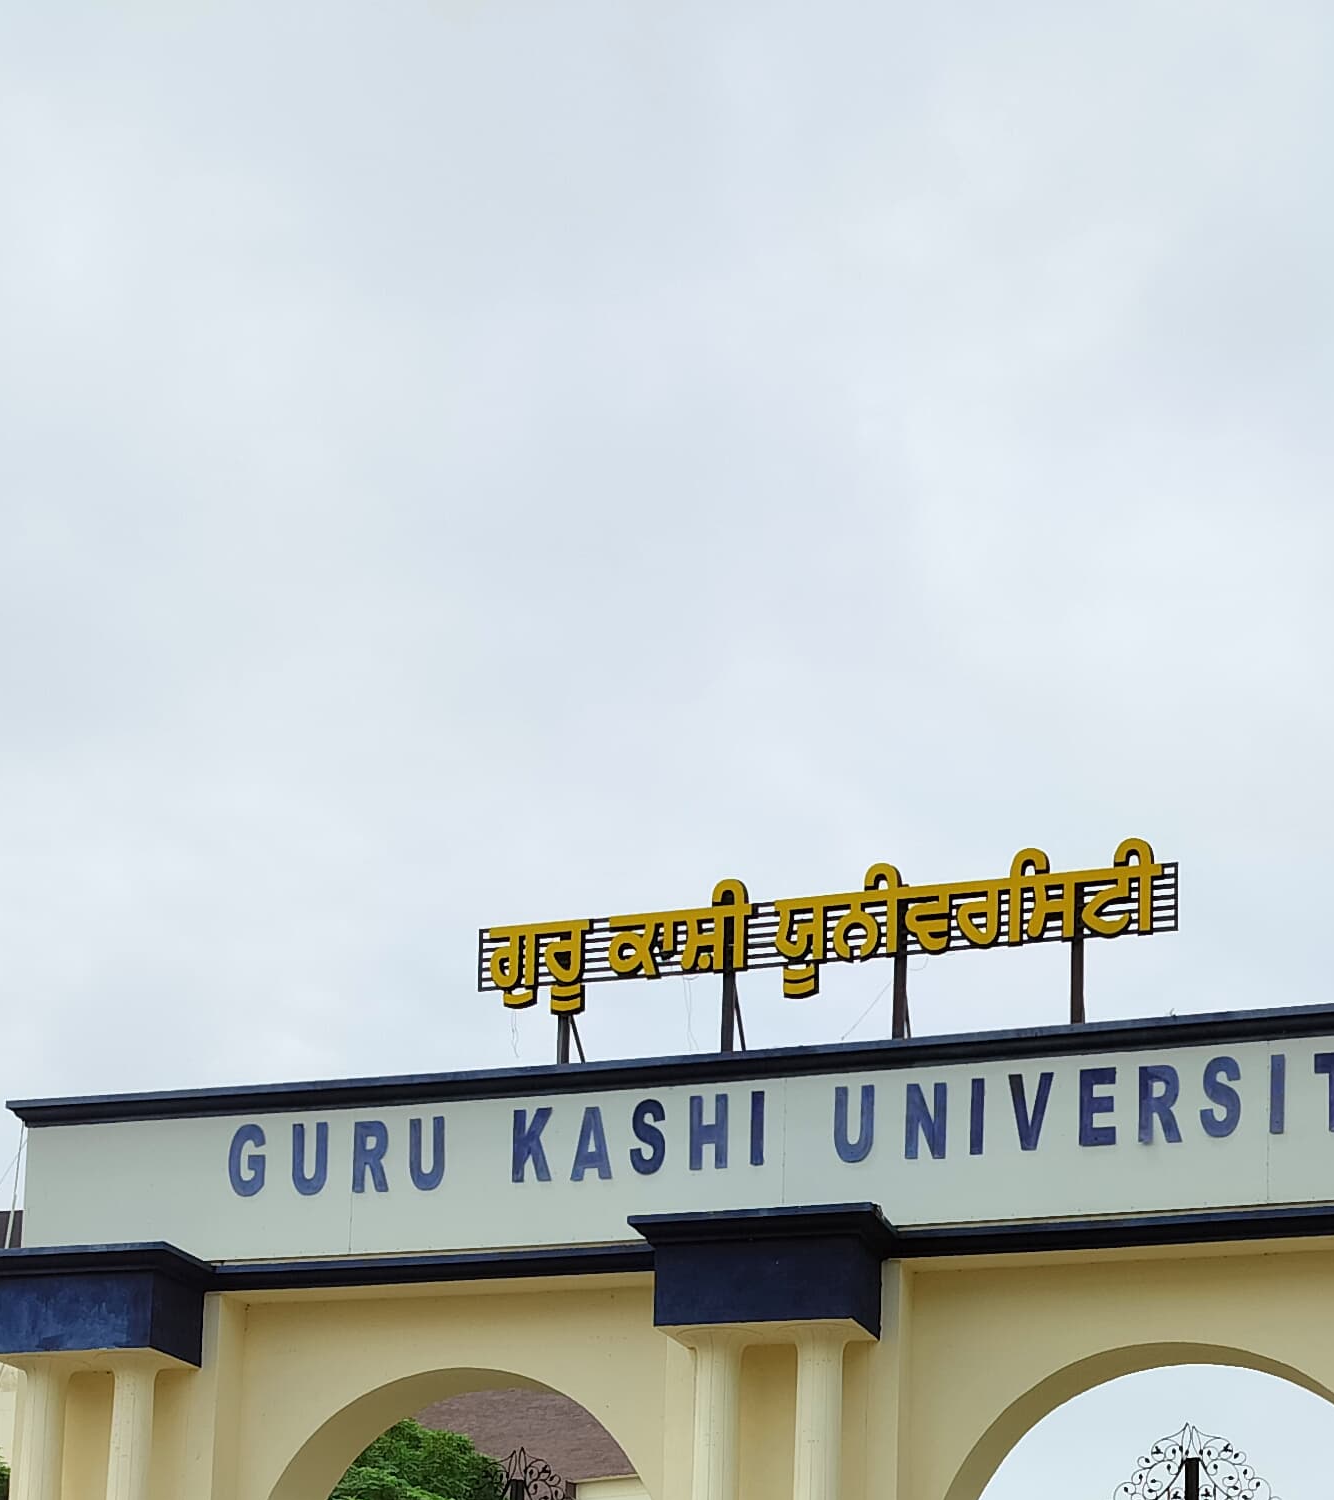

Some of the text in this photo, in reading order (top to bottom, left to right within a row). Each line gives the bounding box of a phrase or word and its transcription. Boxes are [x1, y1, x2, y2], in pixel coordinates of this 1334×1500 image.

[488, 919, 591, 1013] ਗੁਰੂ
[774, 837, 1163, 996] ਯੂਨੀਵਰਸਿਟੀ
[229, 1116, 445, 1196] GURU
[512, 1091, 765, 1184] KASHI
